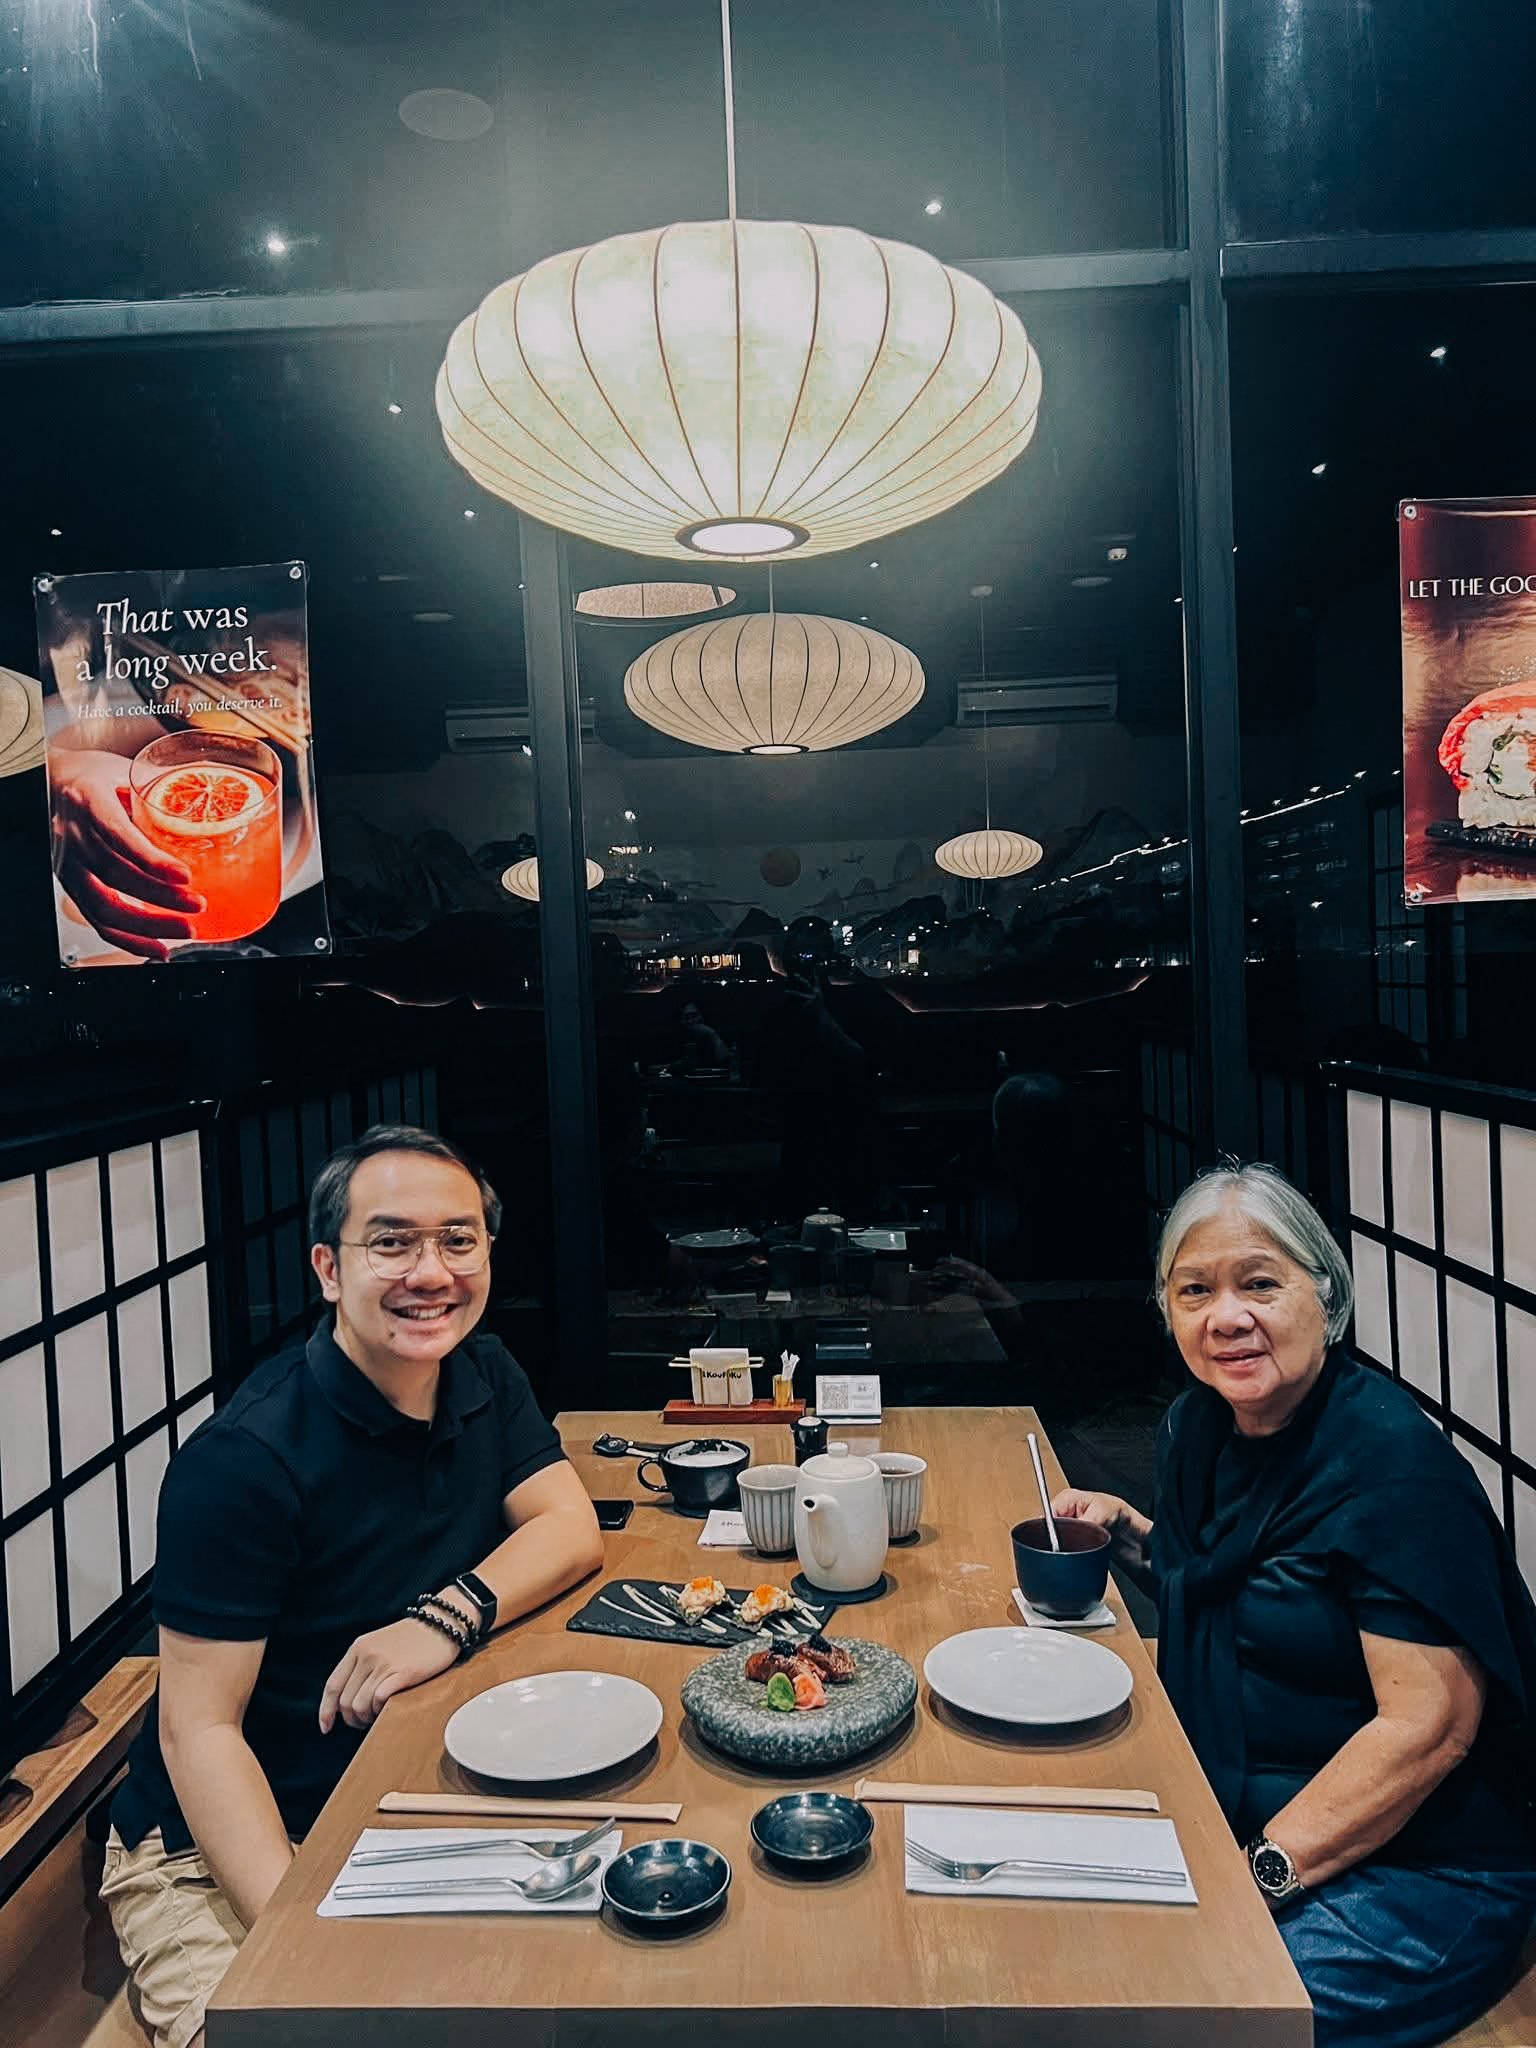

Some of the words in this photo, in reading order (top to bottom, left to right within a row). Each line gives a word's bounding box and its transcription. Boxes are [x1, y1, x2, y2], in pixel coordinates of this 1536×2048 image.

[1409, 579, 1441, 598] LET
[1447, 578, 1484, 596] THE
[97, 597, 173, 635] That
[182, 606, 248, 629] was
[76, 659, 94, 682] a
[103, 645, 170, 690] long
[180, 635, 277, 674] week.
[78, 703, 113, 718] Have
[115, 706, 125, 717] a
[128, 699, 182, 716] cocktail,
[186, 702, 212, 717] you
[216, 696, 264, 711] deserve
[269, 695, 283, 708] it.
